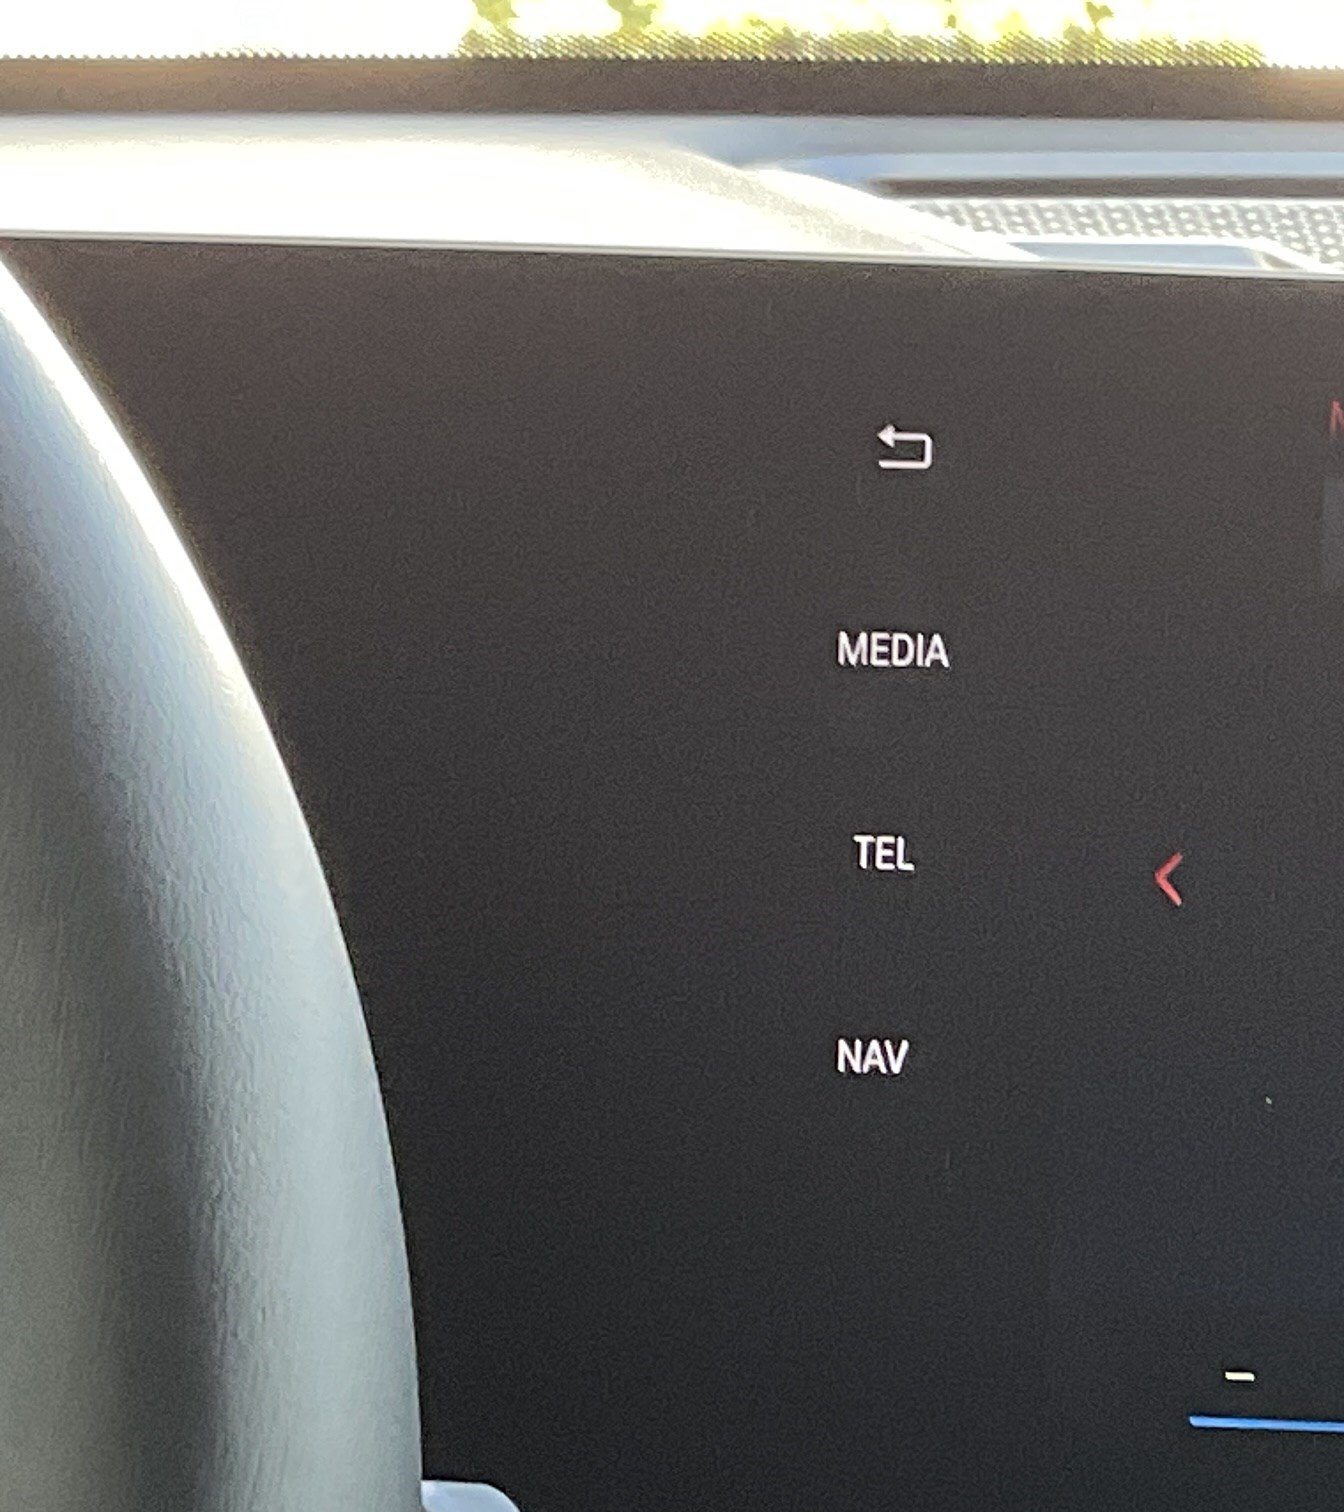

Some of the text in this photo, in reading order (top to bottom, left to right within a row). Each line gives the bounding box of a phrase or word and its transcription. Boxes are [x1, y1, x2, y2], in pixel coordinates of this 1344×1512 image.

[838, 631, 950, 668] MEDIA
[853, 834, 915, 871] TEL
[837, 1038, 909, 1074] NAV
